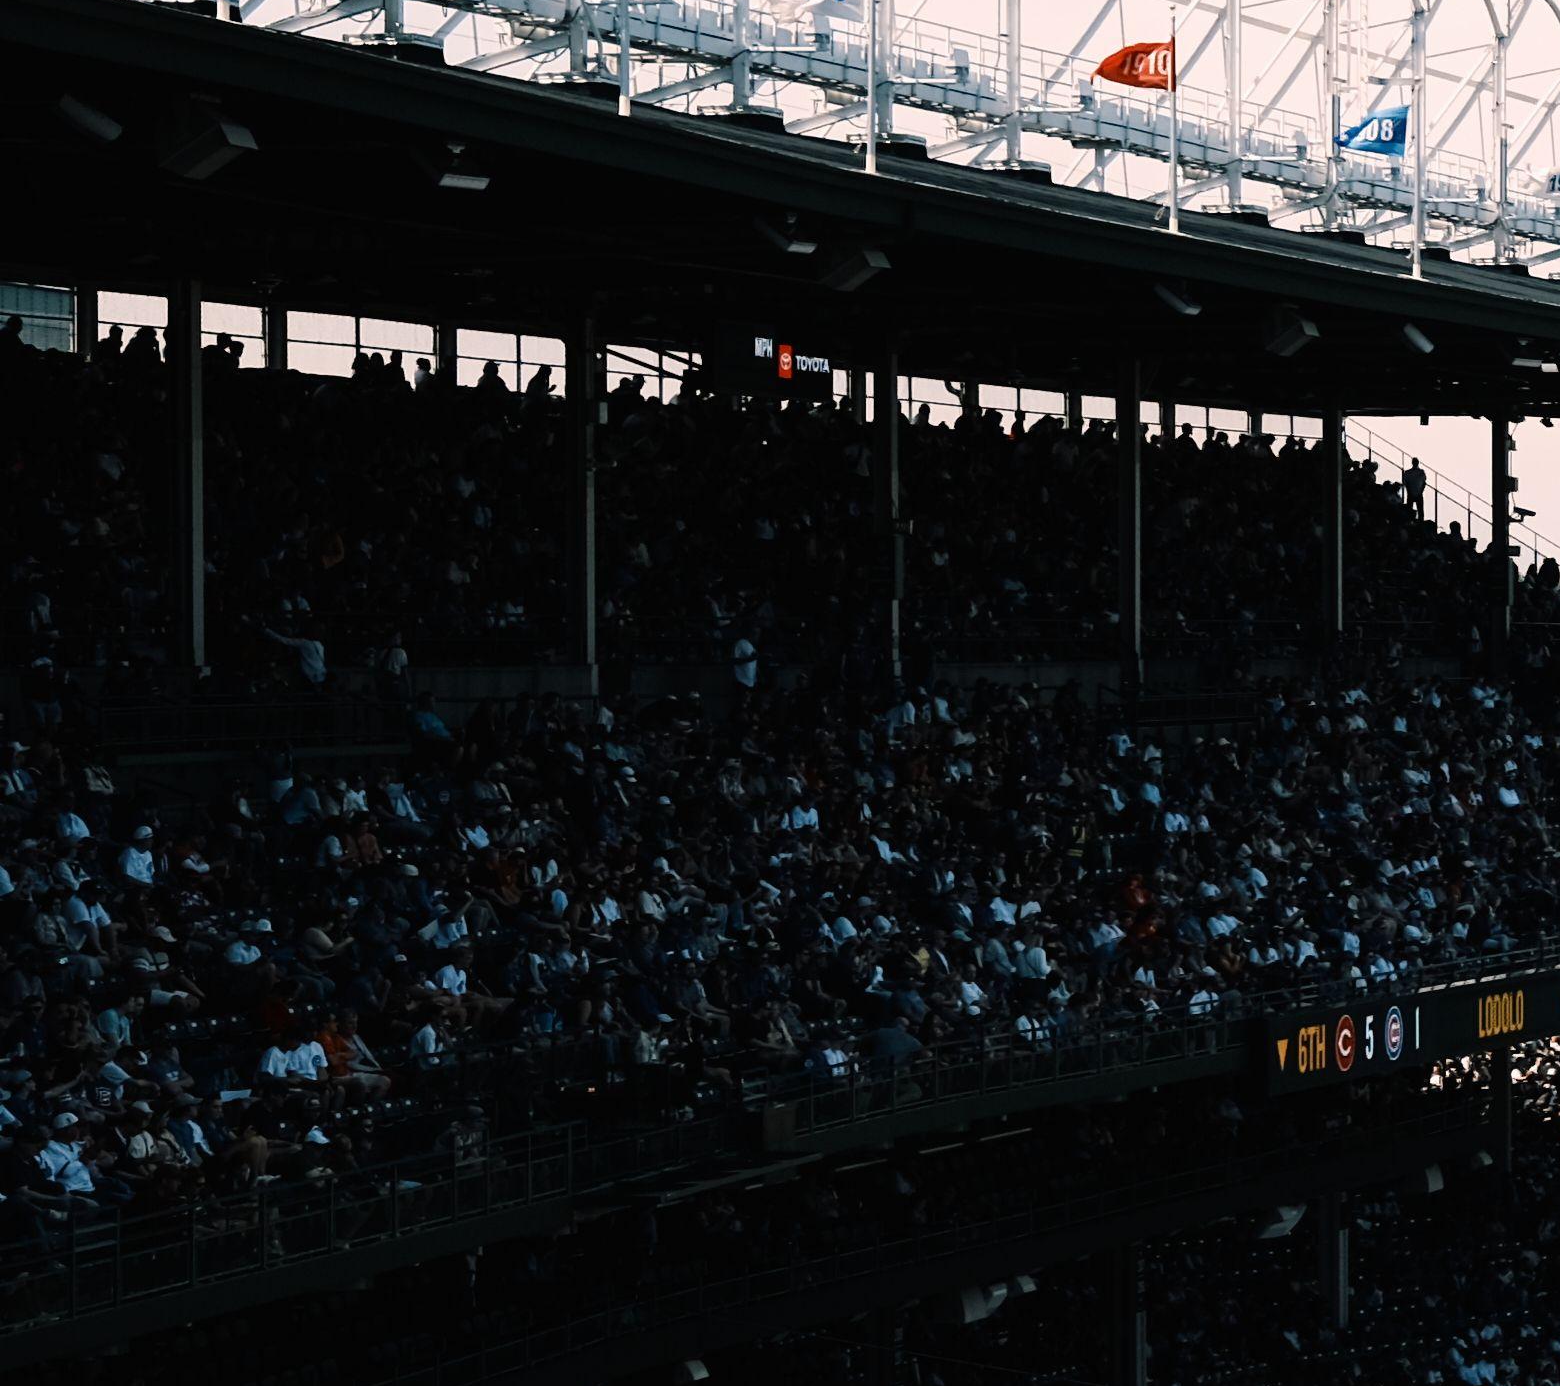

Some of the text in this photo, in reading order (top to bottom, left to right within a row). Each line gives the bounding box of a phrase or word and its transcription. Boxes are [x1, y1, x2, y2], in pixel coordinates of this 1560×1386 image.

[1123, 49, 1171, 75] 1910
[795, 355, 830, 373] TOYOTA
[1298, 1024, 1326, 1075] 6TH
[1365, 1015, 1374, 1060] 5
[1415, 1007, 1420, 1050] 1
[1478, 989, 1525, 1040] LODOLO
